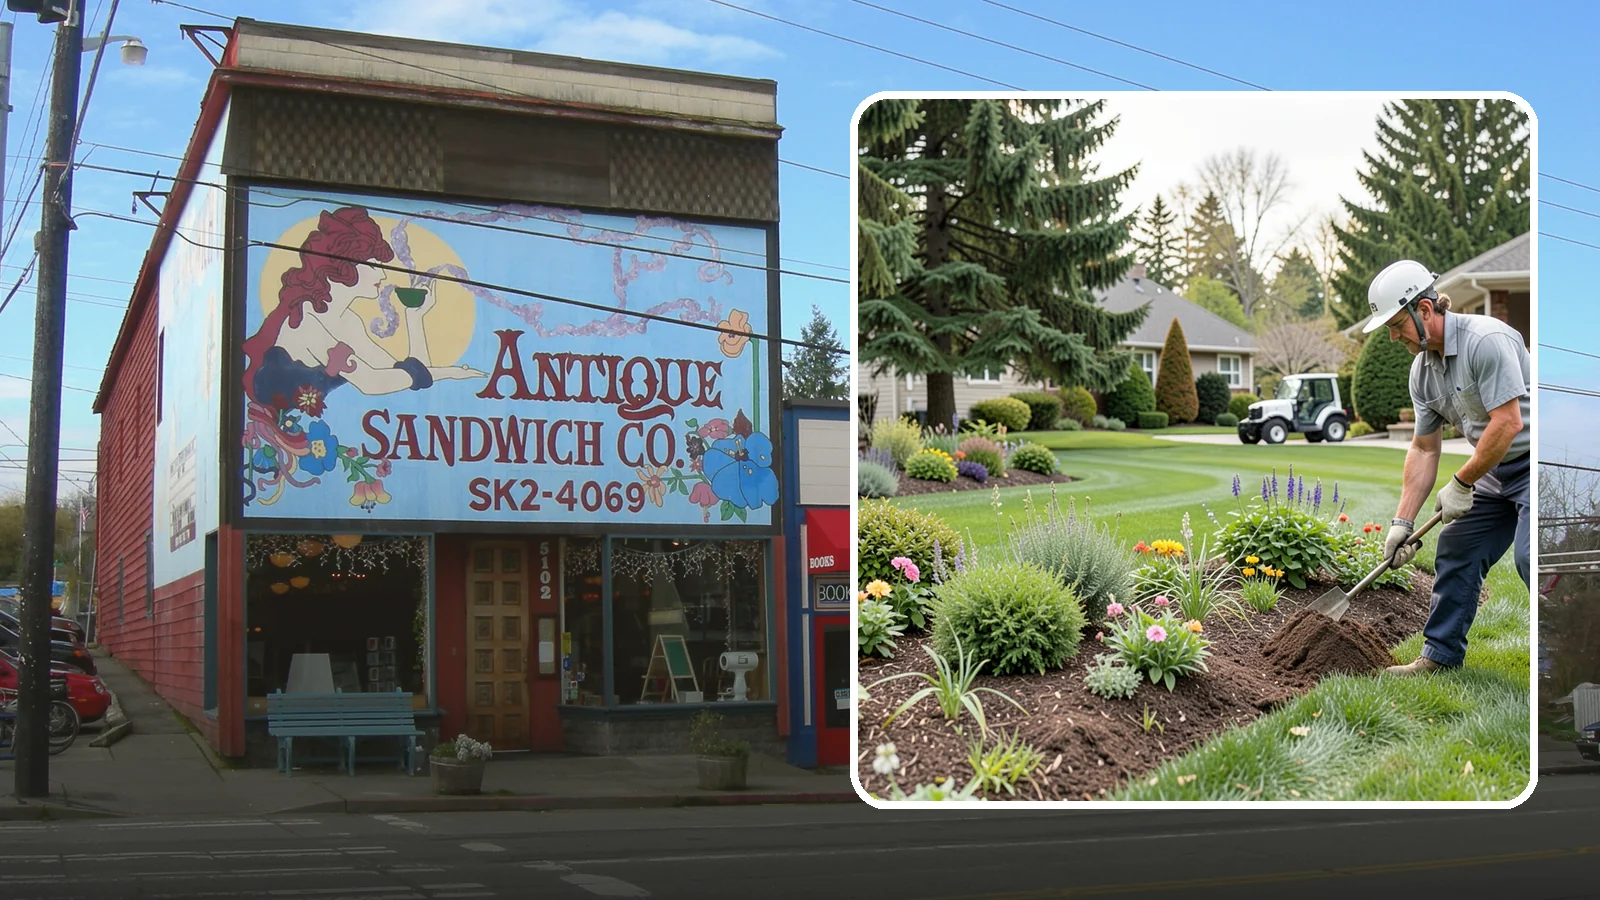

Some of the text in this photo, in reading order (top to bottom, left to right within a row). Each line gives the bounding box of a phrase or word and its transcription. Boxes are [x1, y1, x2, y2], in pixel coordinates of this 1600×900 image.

[476, 329, 723, 420] ANTIQUE
[362, 409, 685, 469] SANDWICH CO.
[468, 477, 646, 512] SK2-4069
[540, 541, 551, 599] 5102
[809, 555, 835, 568] BOOKS
